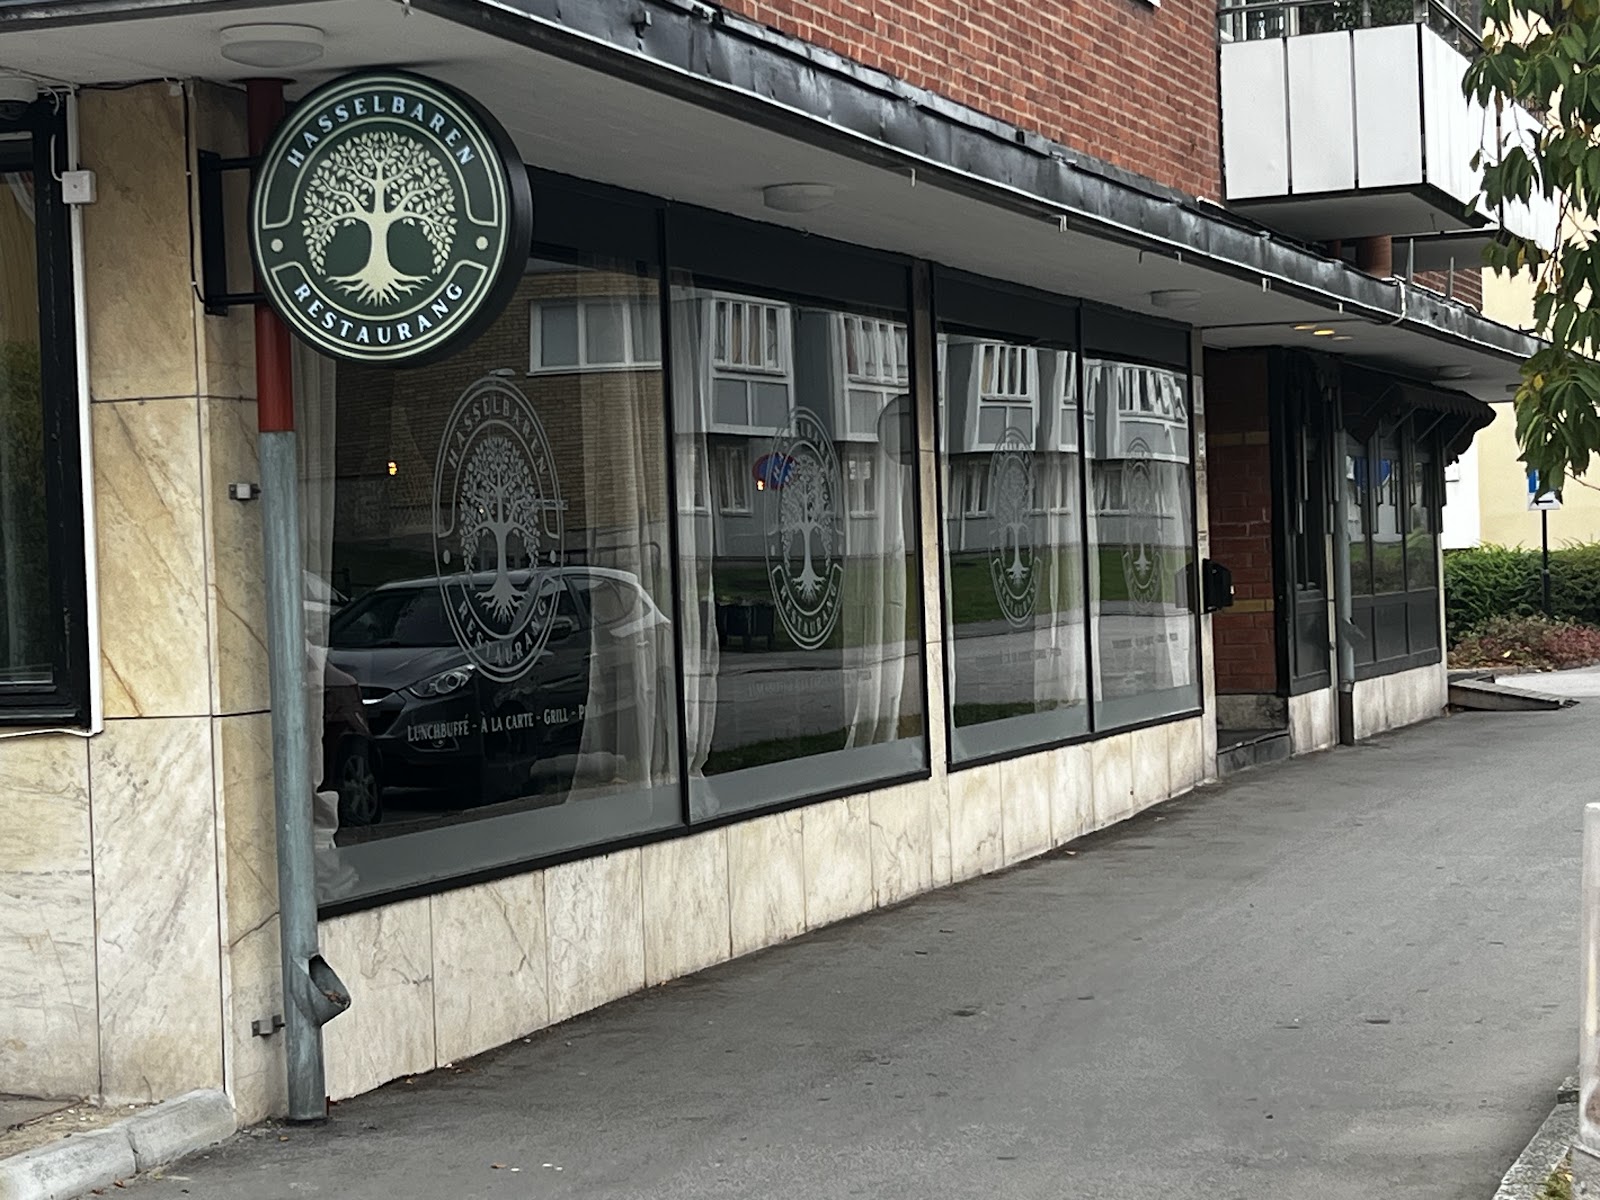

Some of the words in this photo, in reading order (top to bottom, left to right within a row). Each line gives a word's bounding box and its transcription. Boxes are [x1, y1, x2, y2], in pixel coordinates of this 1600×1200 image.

[287, 96, 476, 168] HASSELBAREN
[294, 283, 463, 344] RESTAURANG
[448, 396, 546, 469] HASSELBAREN
[458, 599, 546, 665] RESTAURANG
[407, 713, 469, 742] LUNCHBUFFÉ
[491, 717, 503, 732] LA
[505, 712, 534, 730] CARTE
[544, 708, 569, 725] GRILL
